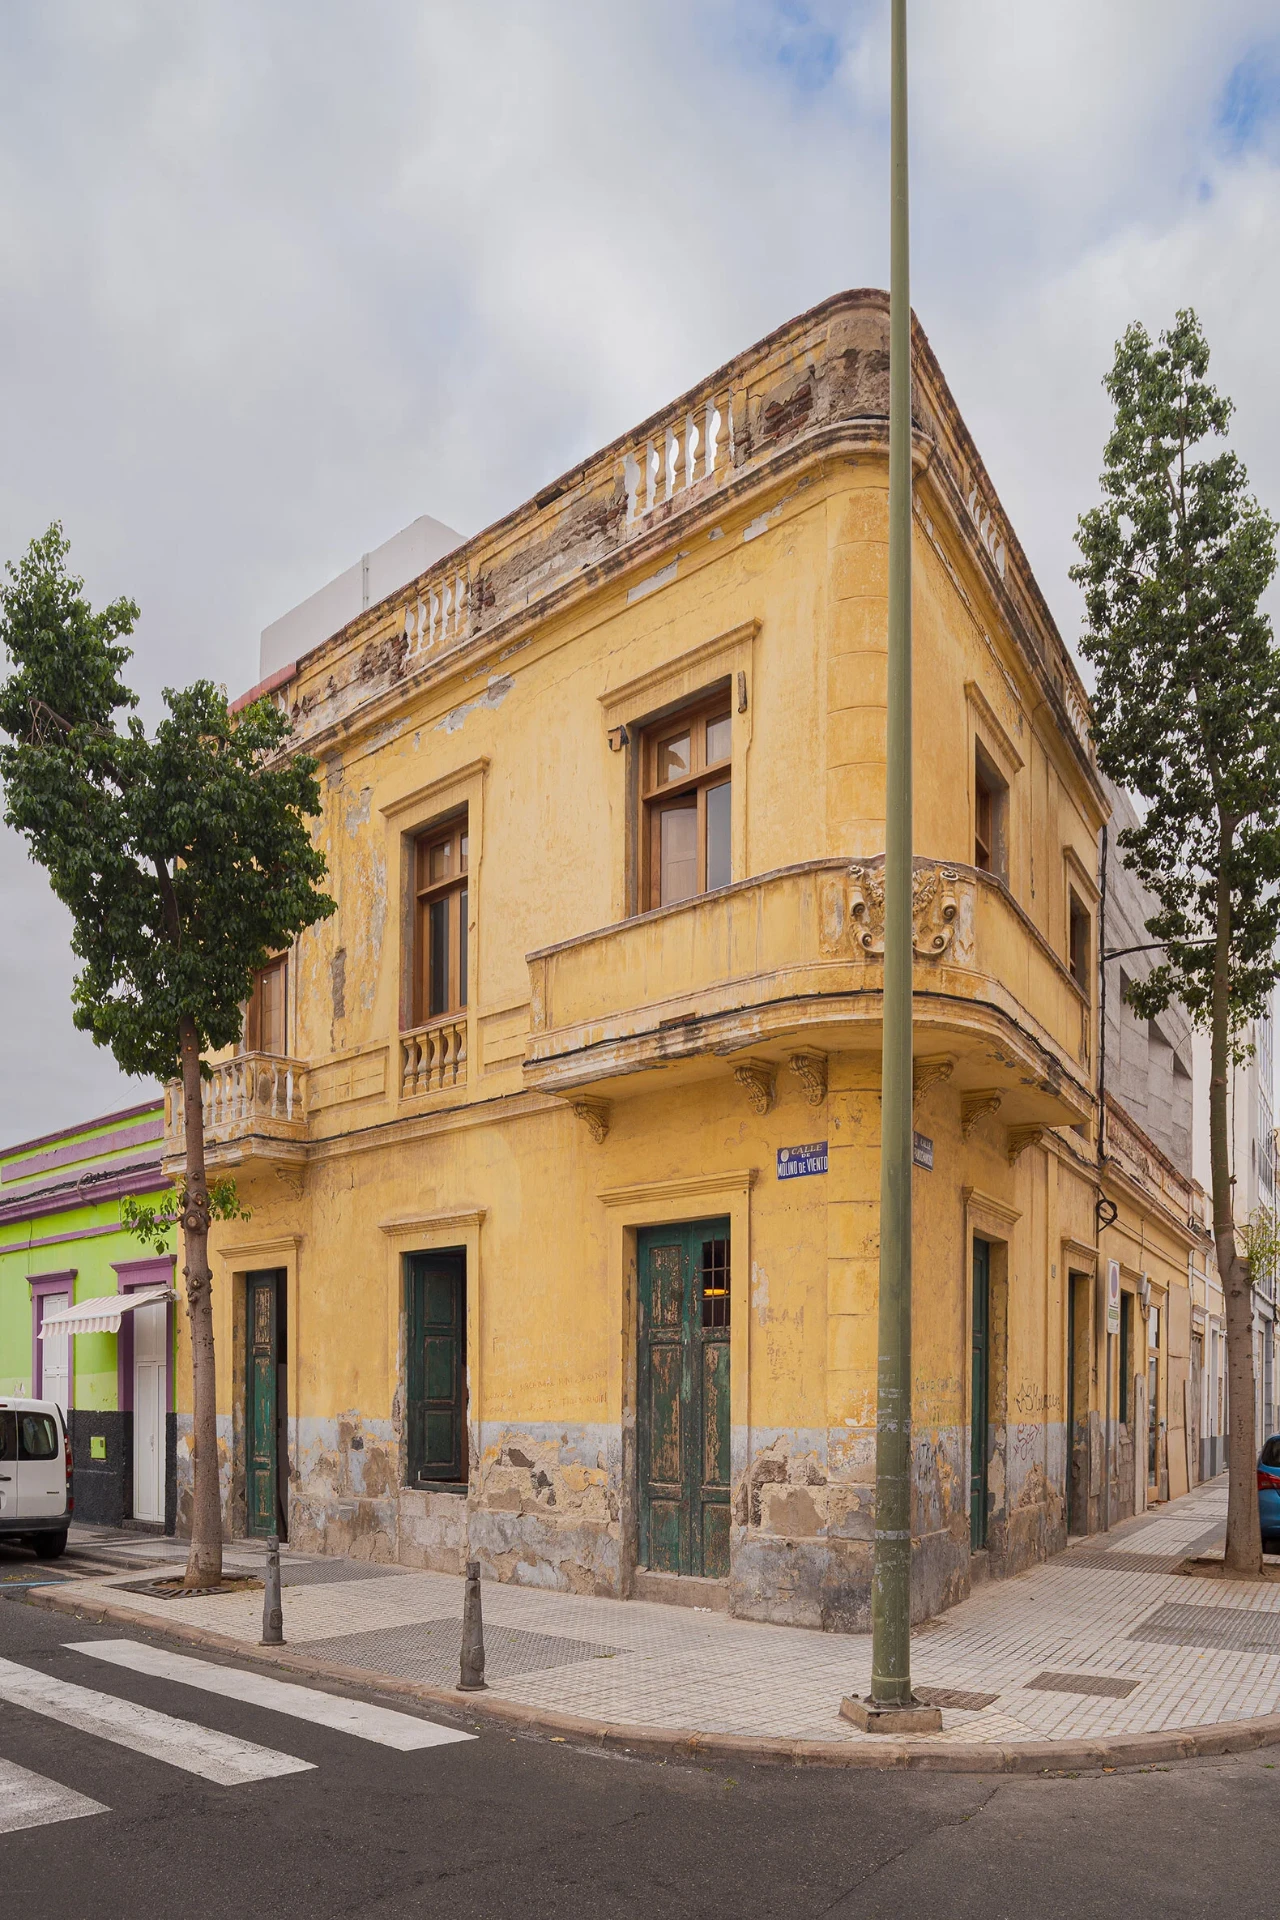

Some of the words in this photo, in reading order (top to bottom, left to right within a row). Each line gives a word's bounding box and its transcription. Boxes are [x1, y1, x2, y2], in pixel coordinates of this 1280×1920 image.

[792, 1144, 823, 1155] CALLE
[777, 1161, 798, 1177] MOLINO
[798, 1162, 807, 1174] DE
[806, 1156, 829, 1172] VIENTO
